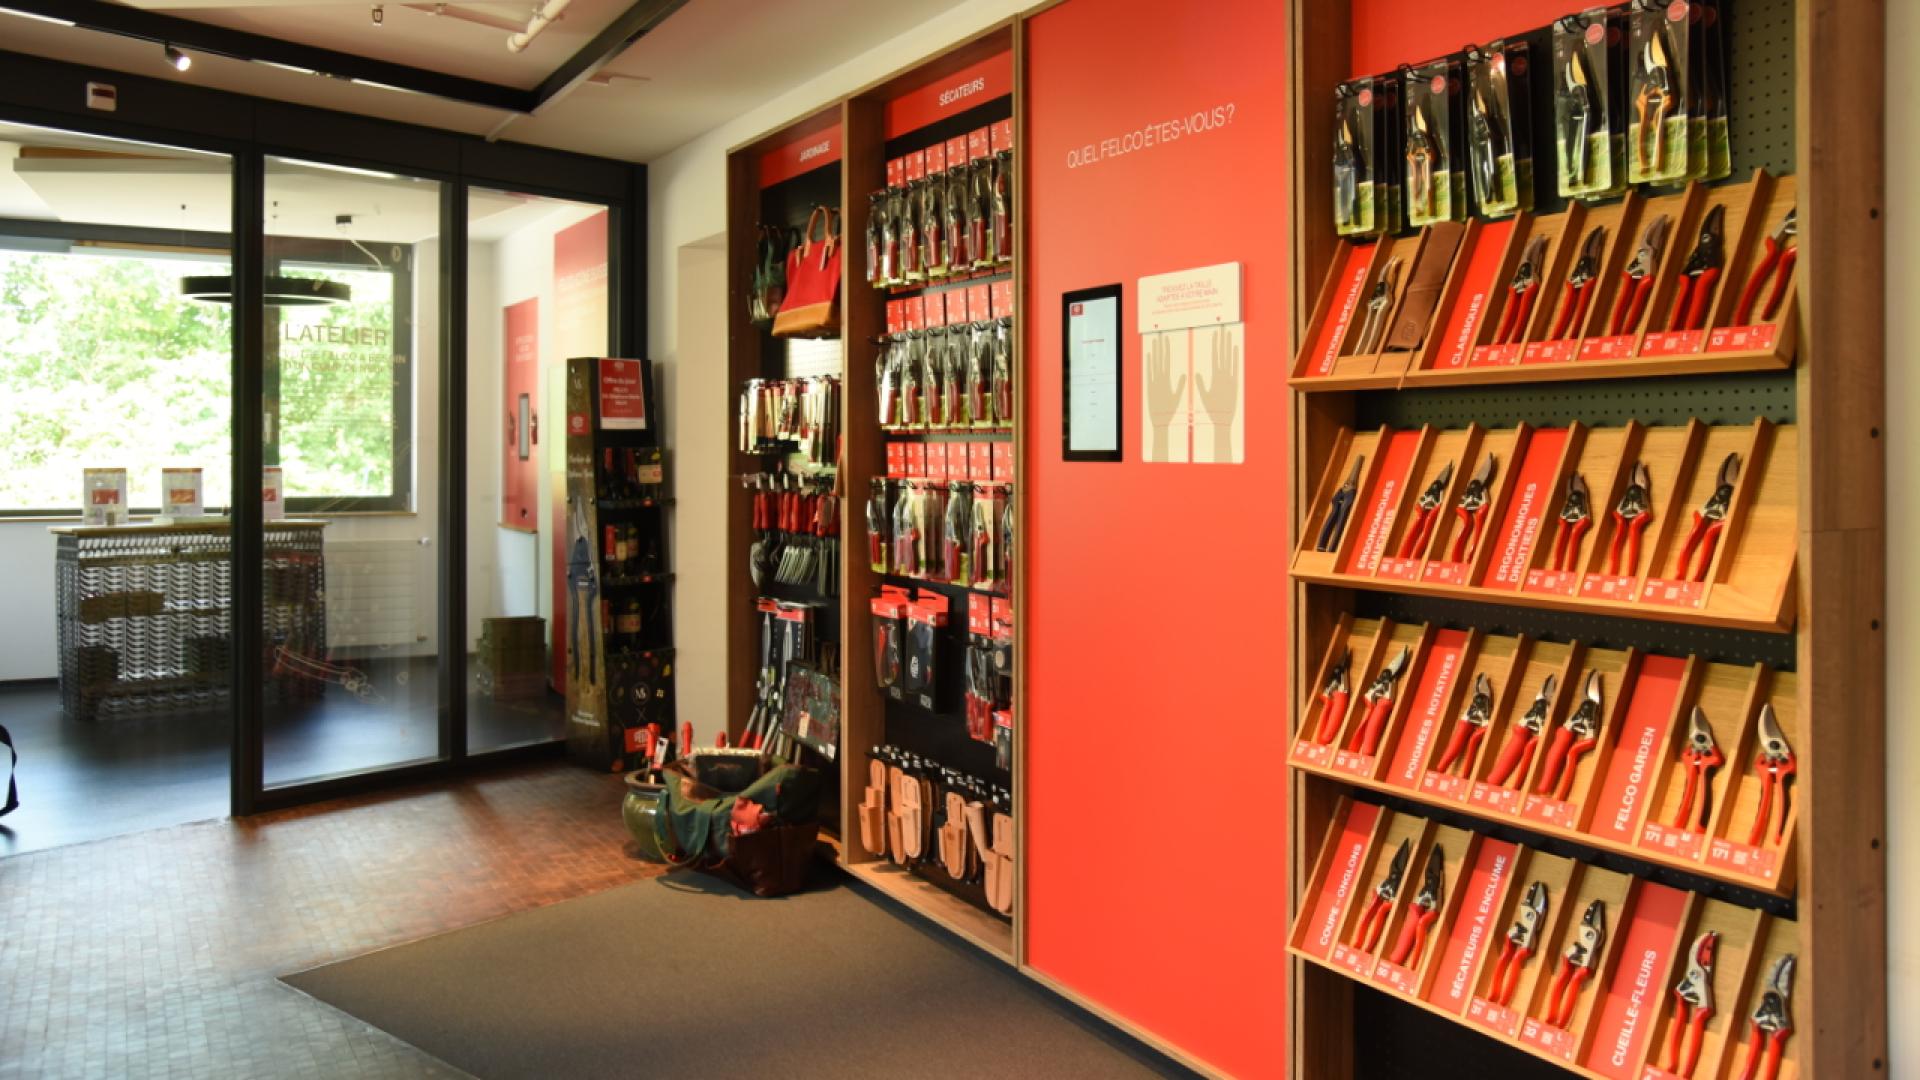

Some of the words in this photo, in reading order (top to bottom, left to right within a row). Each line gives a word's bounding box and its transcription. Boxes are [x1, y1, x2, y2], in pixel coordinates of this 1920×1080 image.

[1067, 144, 1099, 169] QUEL
[1100, 131, 1144, 159] FELCO
[1451, 293, 1484, 366] CLASSIQUES
[1357, 480, 1395, 569] ERGONOMIQUES
[1496, 483, 1537, 581] ERGONOMIQUES
[1510, 518, 1539, 583] DROITIERS
[1427, 653, 1456, 716] ROTATIVES
[1614, 785, 1638, 831] FELCO
[1629, 726, 1656, 784] GARDEN
[1319, 908, 1339, 946] COUPE
[1451, 924, 1482, 999] SÉCATEURS
[1481, 855, 1507, 915] ENCLUME
[1611, 950, 1657, 1067] CUEILLE-FLEURS
